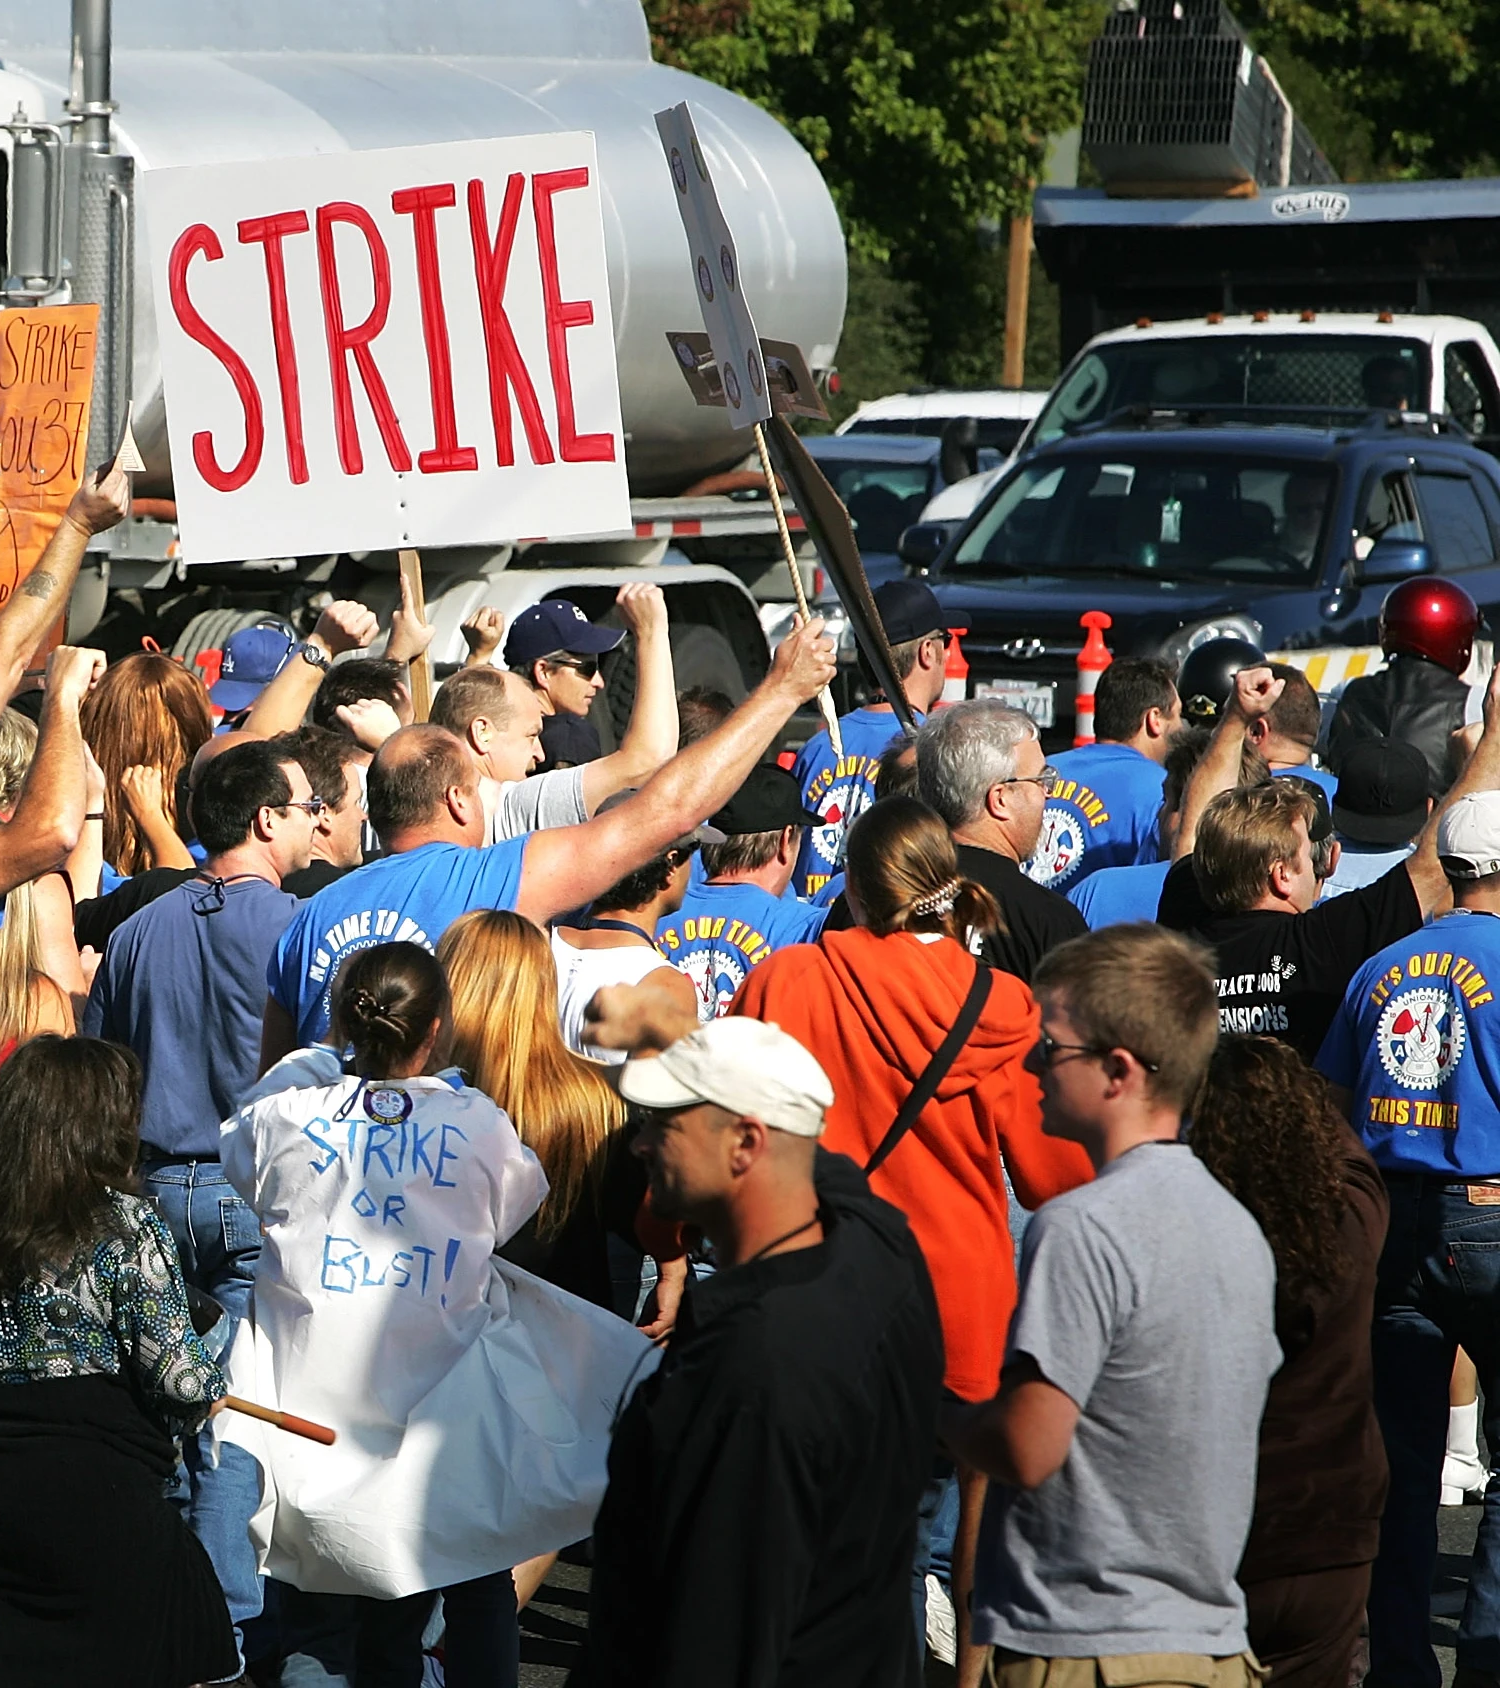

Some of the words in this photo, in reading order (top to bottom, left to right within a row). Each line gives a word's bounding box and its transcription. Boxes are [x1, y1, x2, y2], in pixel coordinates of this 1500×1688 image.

[169, 166, 616, 492] STRIKE
[28, 398, 85, 486] 37
[807, 768, 833, 802] IT'S
[1052, 780, 1078, 800] UR
[1074, 786, 1111, 828] TIME
[309, 947, 331, 982] NO
[325, 910, 372, 953] TIME
[375, 909, 399, 937] TO
[684, 916, 727, 942] OUR
[1214, 973, 1255, 998] TRACT
[1370, 965, 1404, 1006] IT'S
[1407, 952, 1453, 979] OUR
[1451, 957, 1494, 1010] TIME
[1217, 1003, 1289, 1034] ENSIONS
[1403, 994, 1434, 1006] UNION
[1395, 1044, 1405, 1057] A
[1394, 1066, 1433, 1084] CONTRACT
[1370, 1096, 1409, 1125] THIS
[301, 1116, 469, 1188] STRIKE
[351, 1187, 407, 1227] OR
[321, 1234, 461, 1310] BUST!
